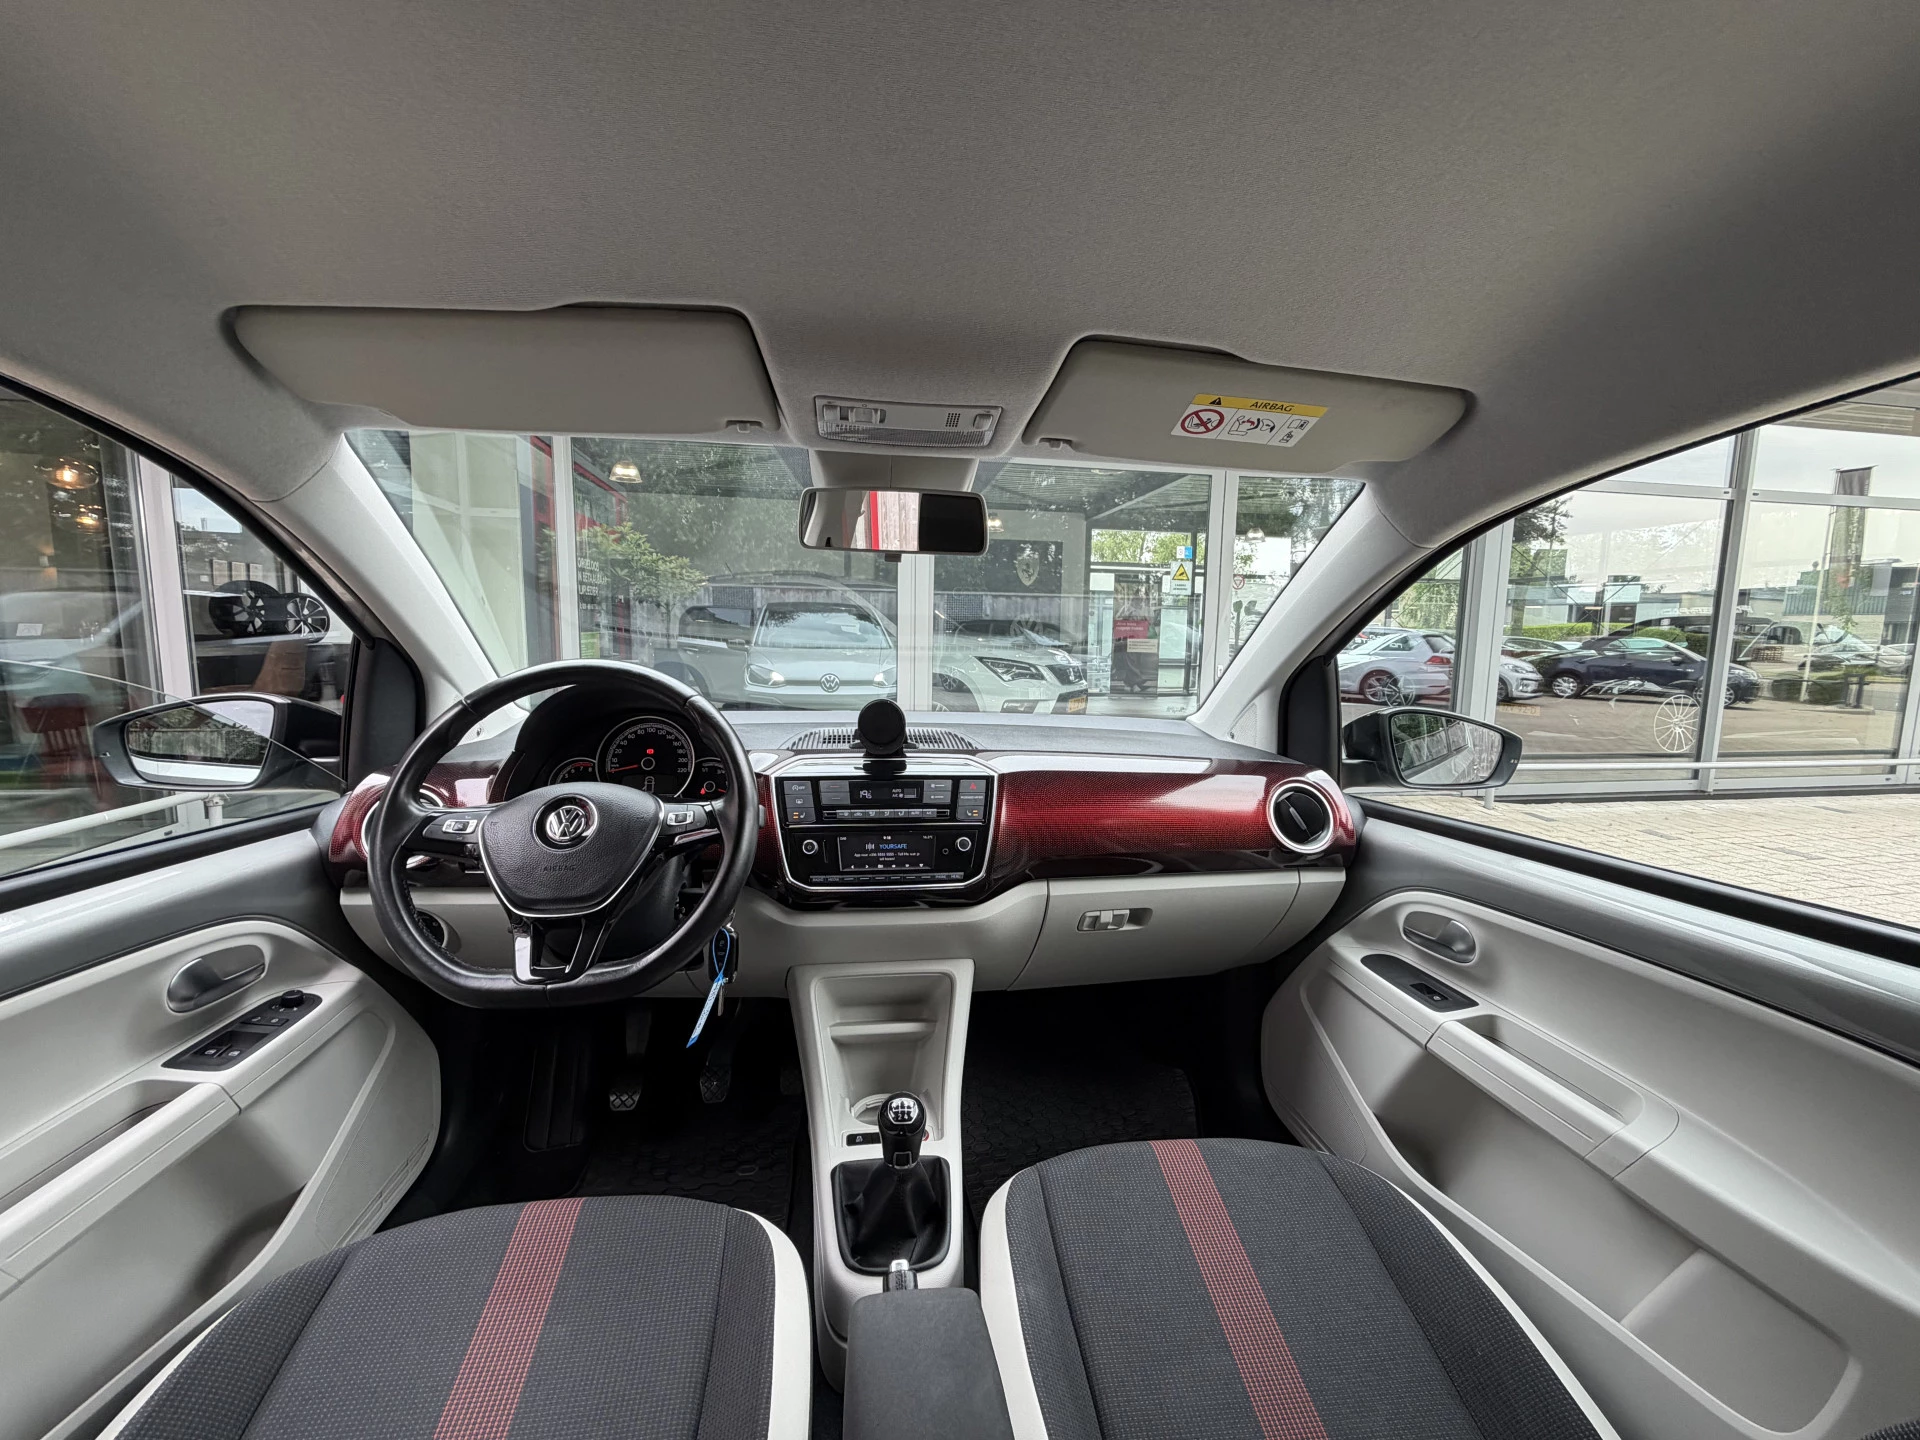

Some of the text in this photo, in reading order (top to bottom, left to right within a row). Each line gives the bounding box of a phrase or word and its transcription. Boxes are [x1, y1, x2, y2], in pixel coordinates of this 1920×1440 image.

[1249, 401, 1294, 412] AIRBAG
[577, 557, 600, 571] ORGELOOS
[543, 865, 576, 873] AIRBAG
